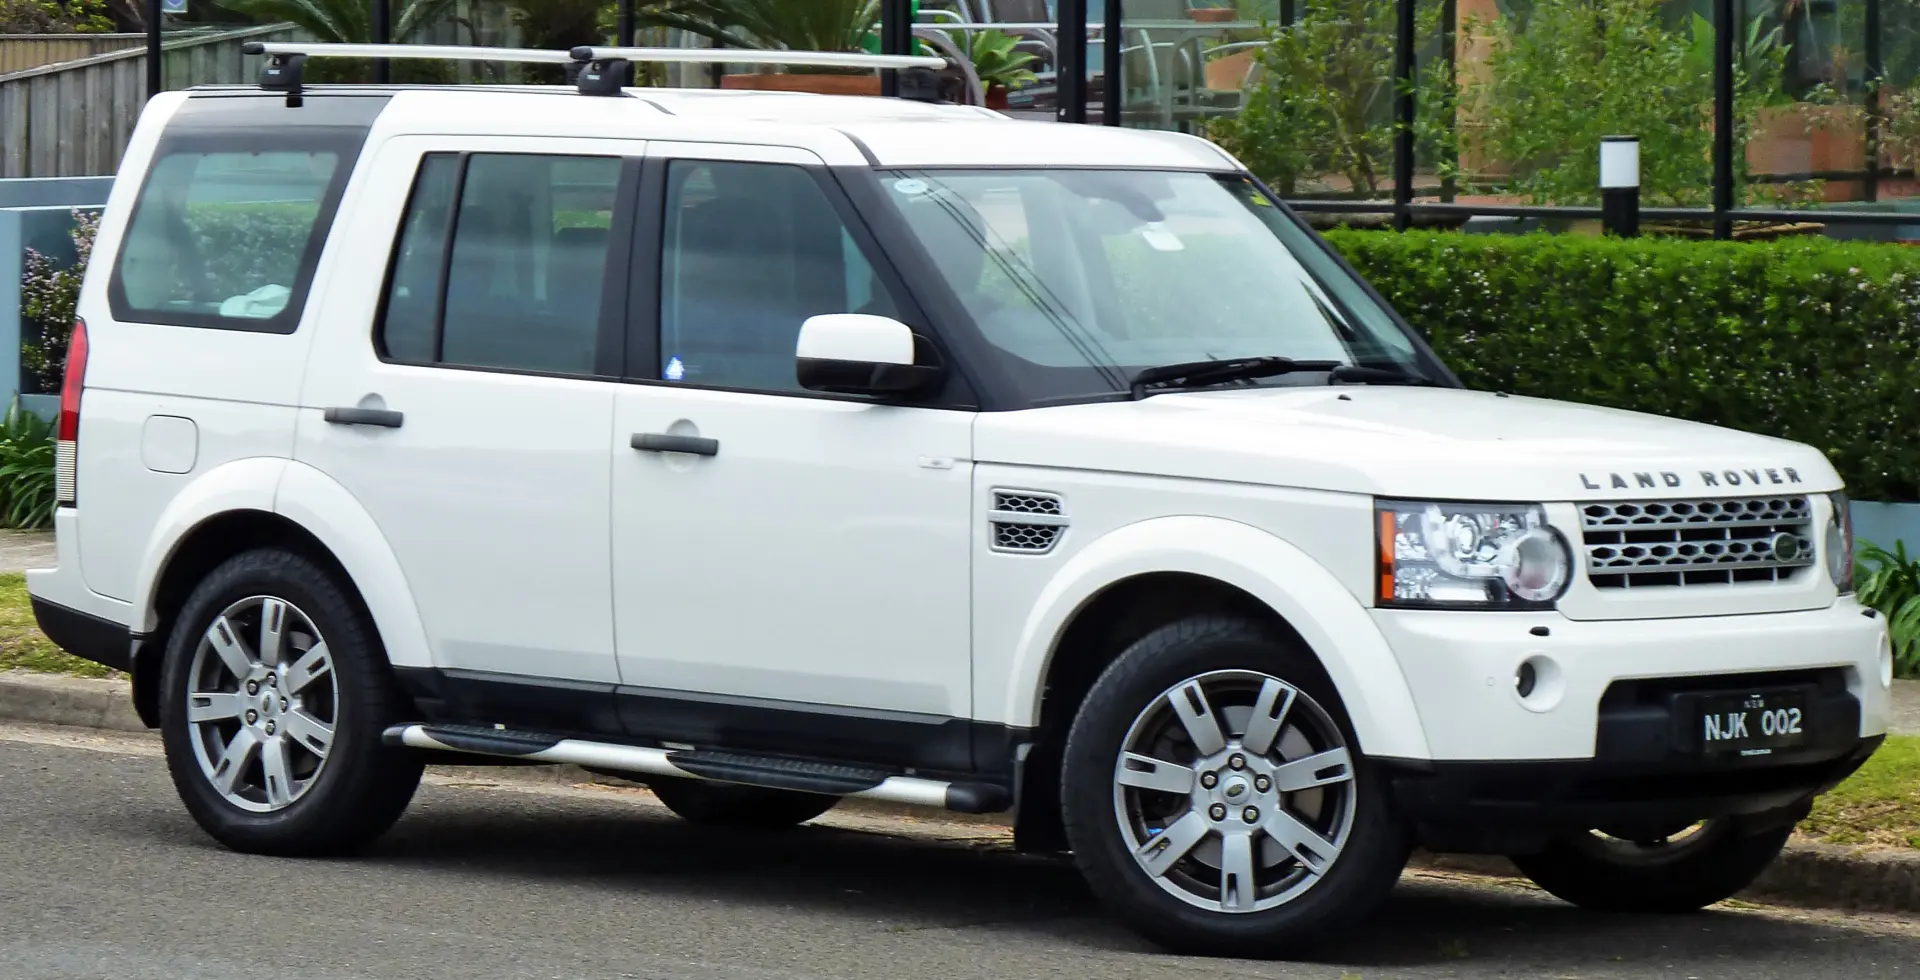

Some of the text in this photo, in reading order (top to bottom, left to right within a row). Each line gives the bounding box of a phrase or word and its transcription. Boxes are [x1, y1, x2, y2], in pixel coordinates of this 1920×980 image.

[1579, 467, 1802, 490] LAND ROVER
[1704, 707, 1802, 740] NJK 002
